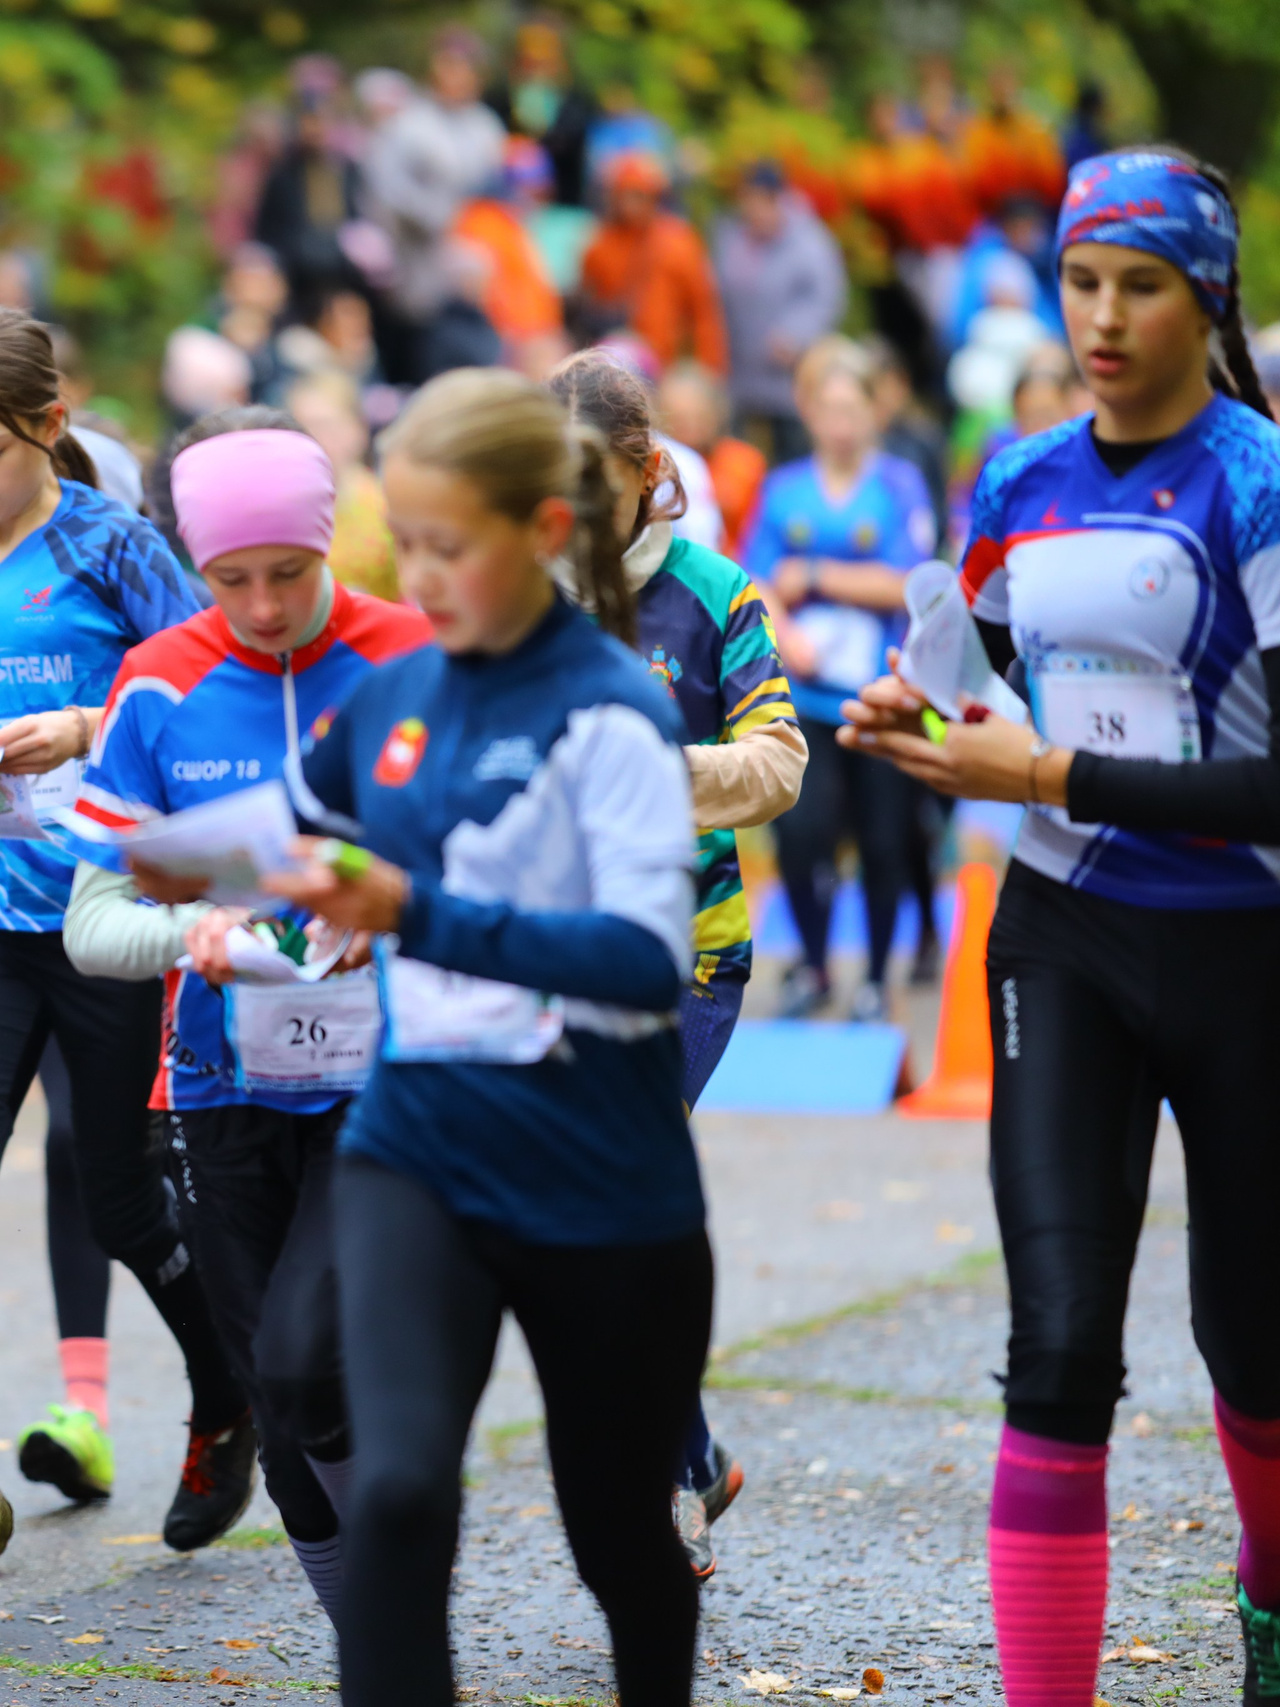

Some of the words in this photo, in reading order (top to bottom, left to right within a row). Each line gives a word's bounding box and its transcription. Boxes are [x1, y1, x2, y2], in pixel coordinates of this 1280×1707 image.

[1087, 711, 1126, 743] 38
[171, 759, 232, 781] СШОР
[235, 759, 262, 779] 18
[287, 1015, 327, 1046] 26
